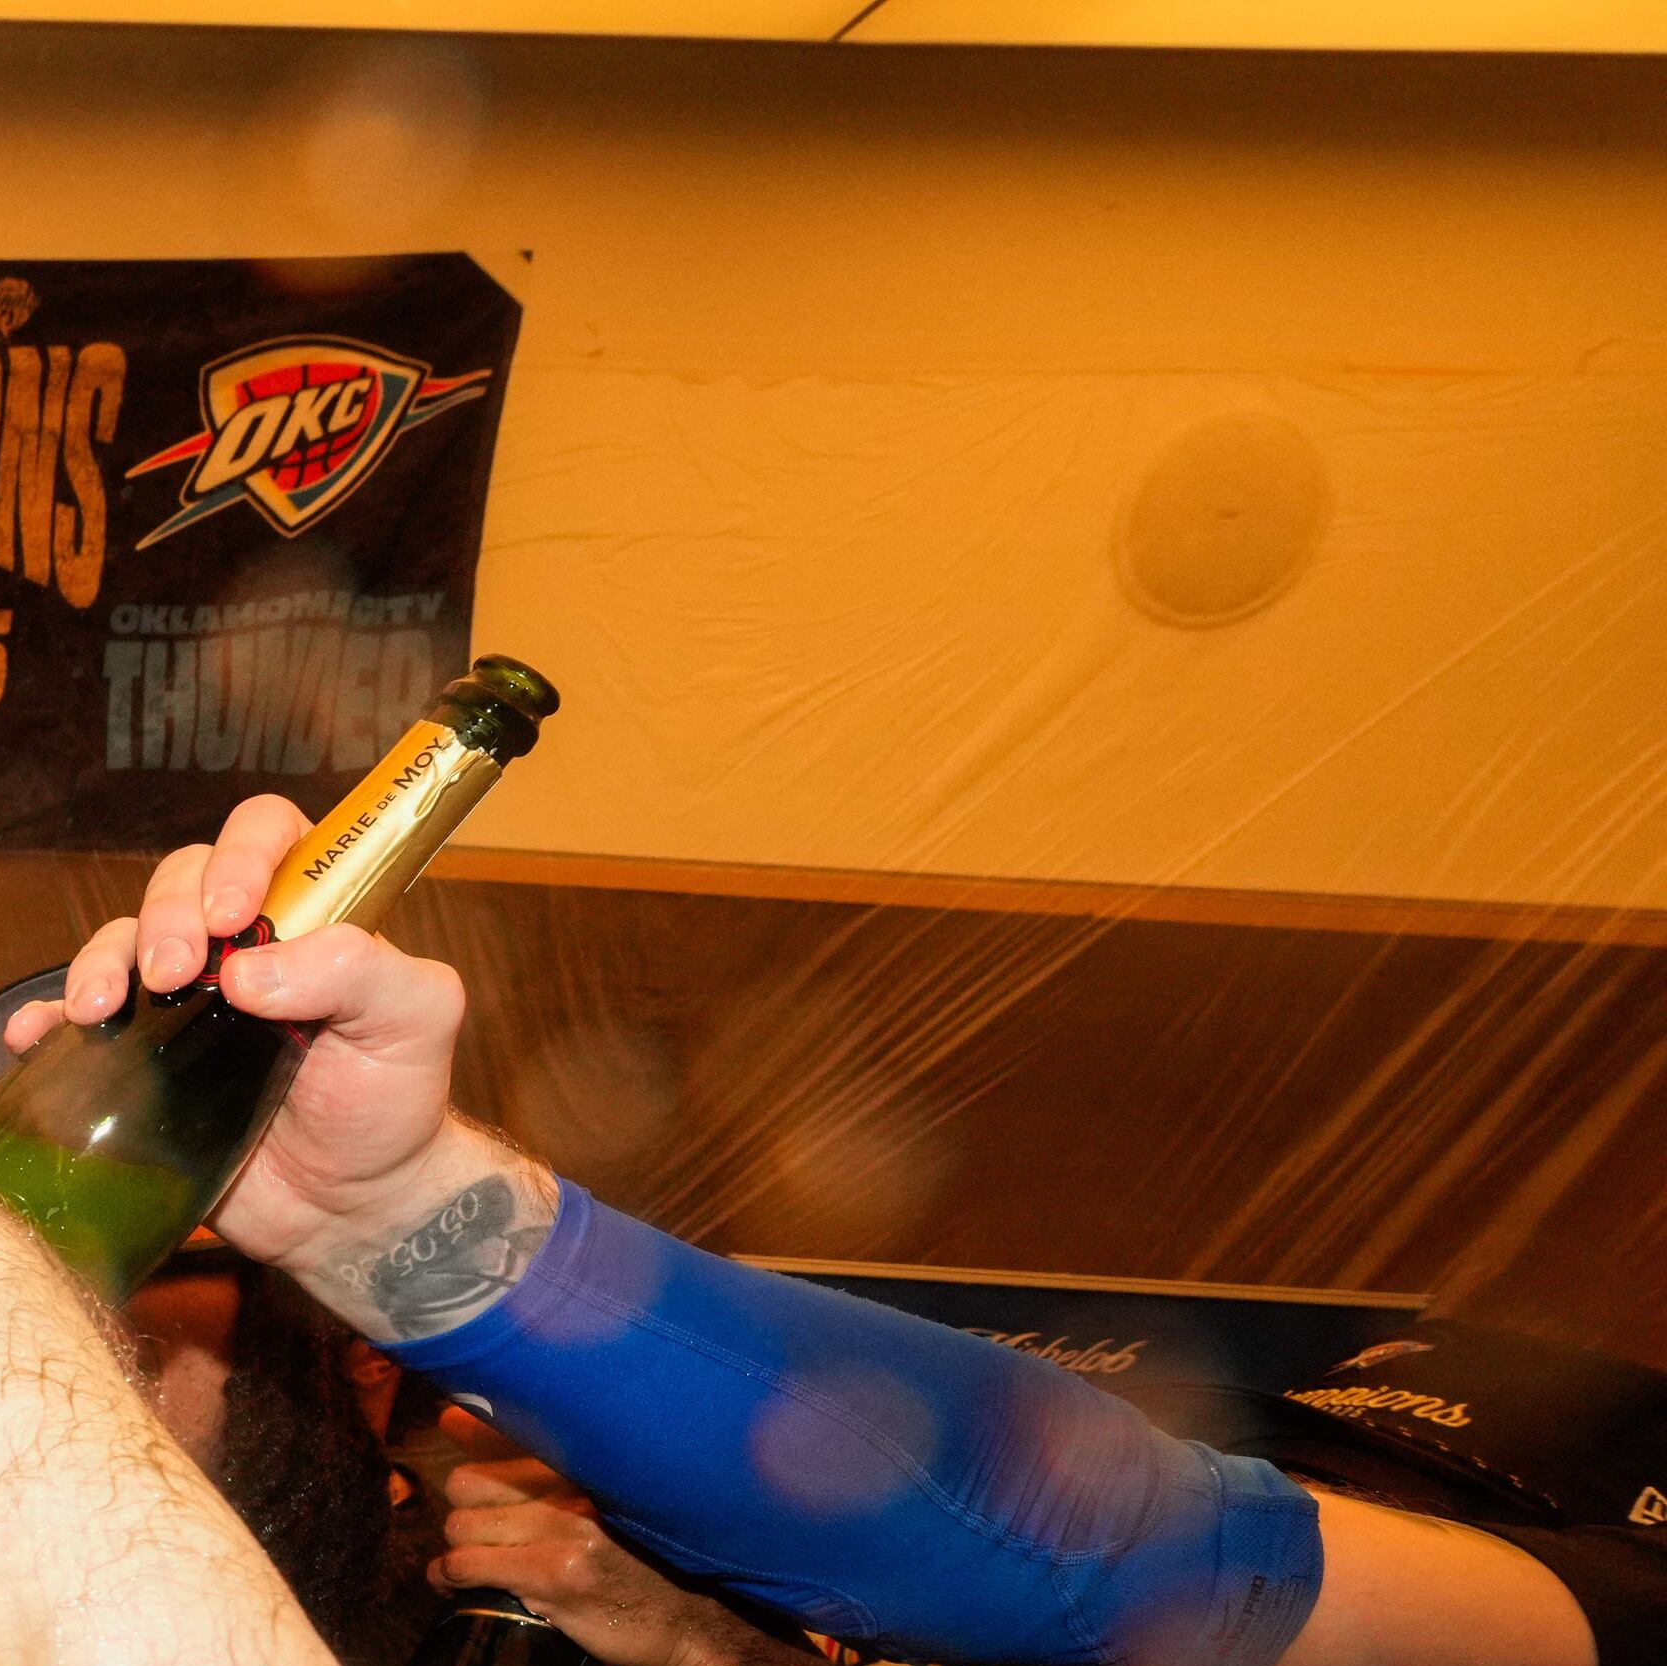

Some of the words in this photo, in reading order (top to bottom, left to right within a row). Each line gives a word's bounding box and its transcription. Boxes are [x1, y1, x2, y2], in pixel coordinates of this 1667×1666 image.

[194, 374, 370, 495] OKC
[109, 589, 353, 634] OKLAHOMA
[351, 590, 445, 625] CITY
[101, 629, 435, 776] THUNDER
[302, 812, 378, 882] MARIE
[376, 792, 397, 813] DE
[393, 736, 445, 790] MOY
